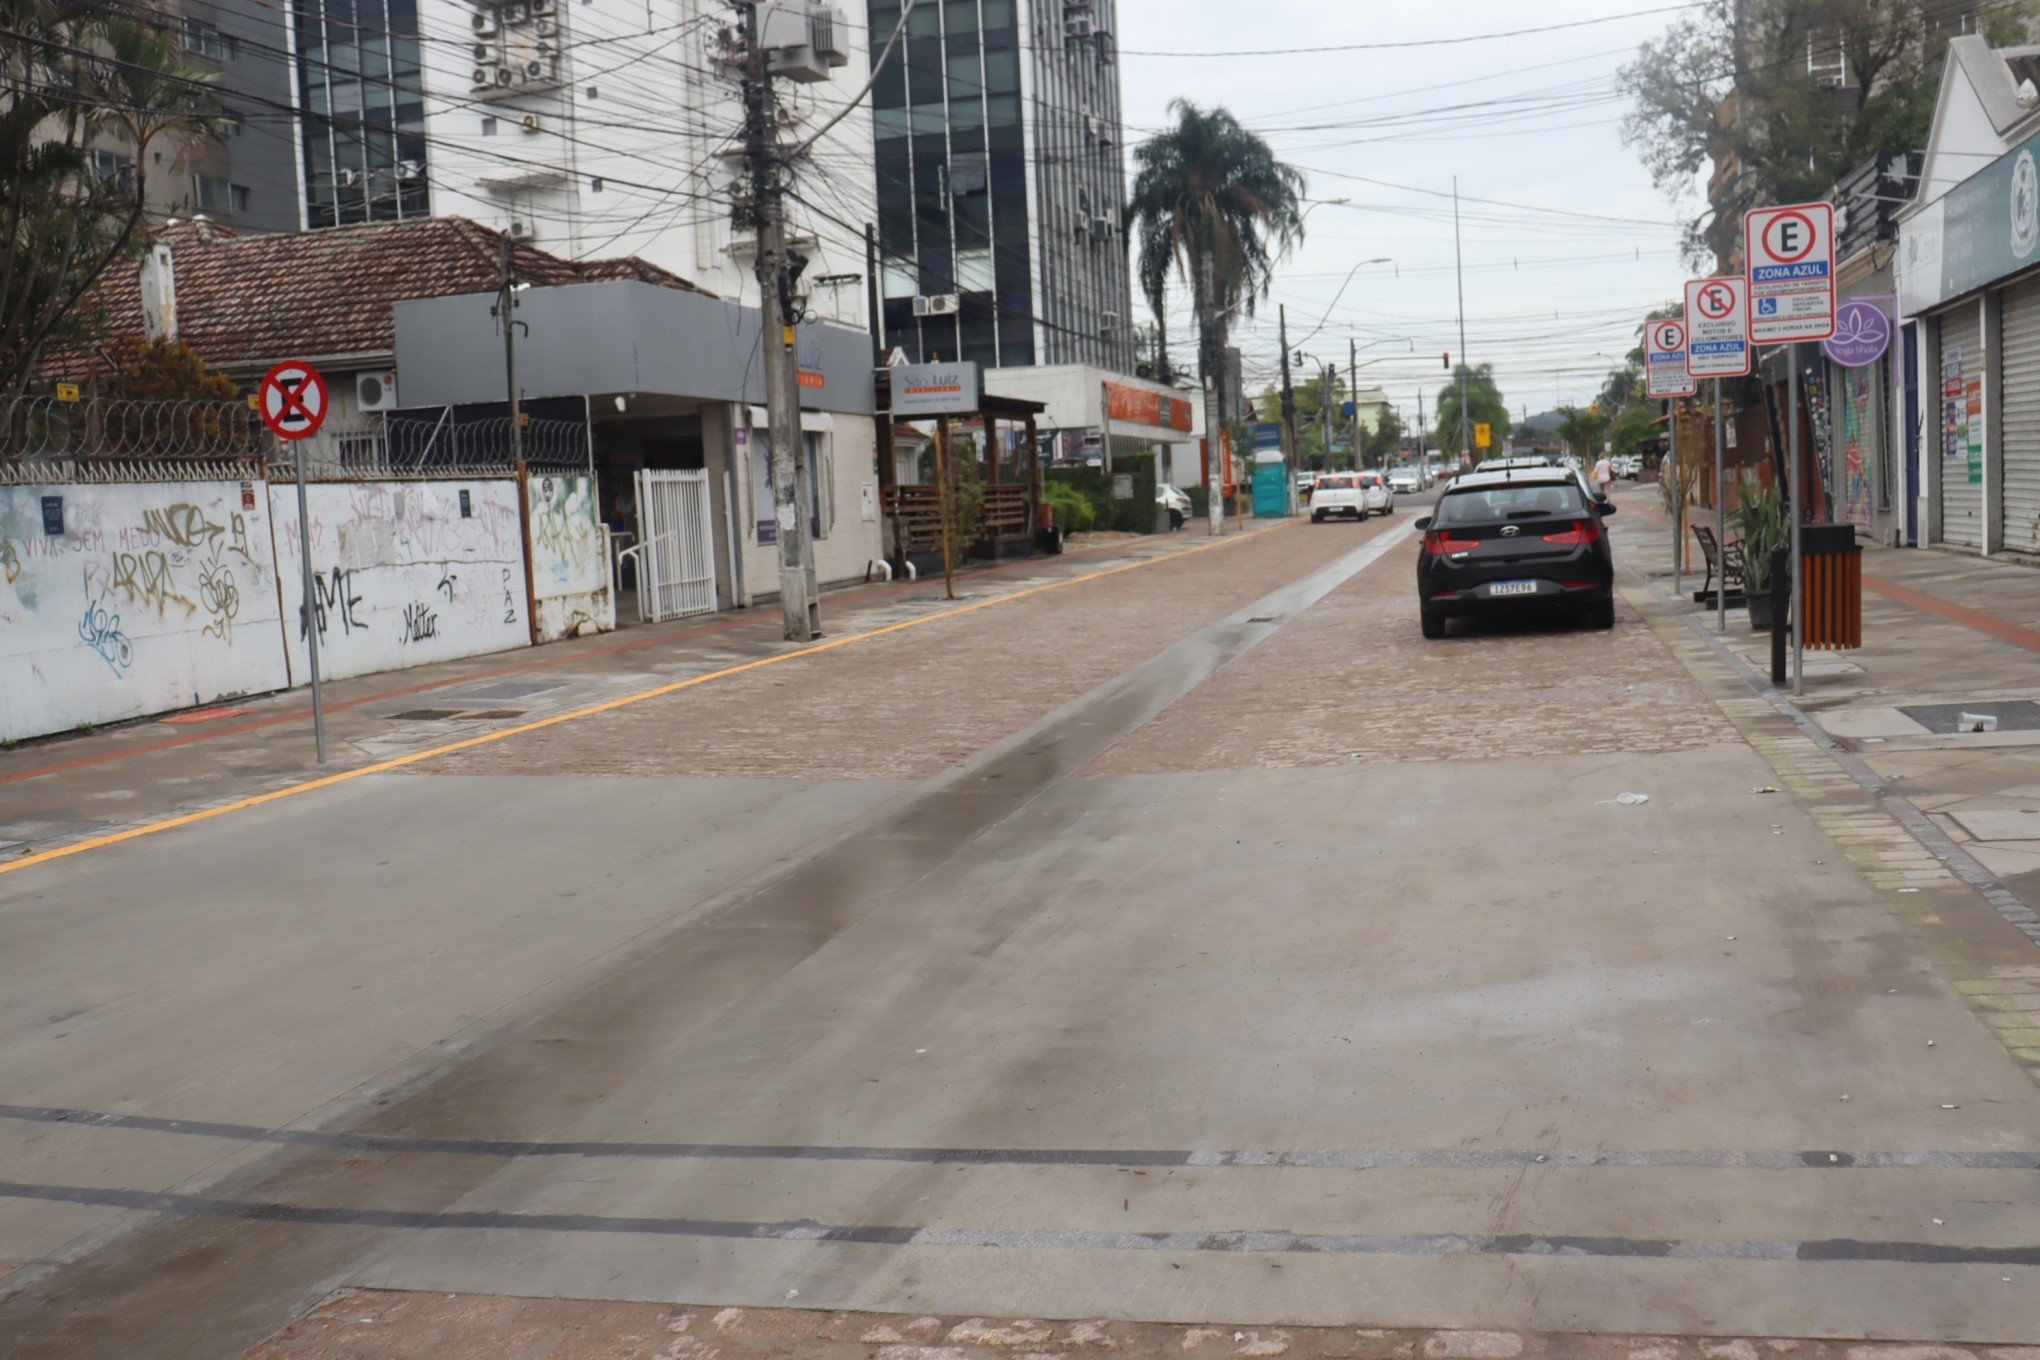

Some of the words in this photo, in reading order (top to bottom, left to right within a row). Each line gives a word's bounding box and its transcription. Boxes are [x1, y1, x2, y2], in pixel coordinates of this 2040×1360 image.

[1780, 222, 1798, 252] E
[1758, 267, 1790, 280] ZONA
[1792, 264, 1823, 276] AZUL
[1710, 290, 1722, 311] E
[1698, 320, 1736, 328] EXCLUSIVO
[1665, 328, 1675, 346] E
[1695, 345, 1716, 353] ZONA
[1720, 343, 1742, 351] AZUL
[904, 374, 928, 386] São
[932, 374, 959, 386] Luiz
[280, 378, 306, 422] E
[22, 537, 58, 558] VIVA
[73, 529, 106, 553] SEM
